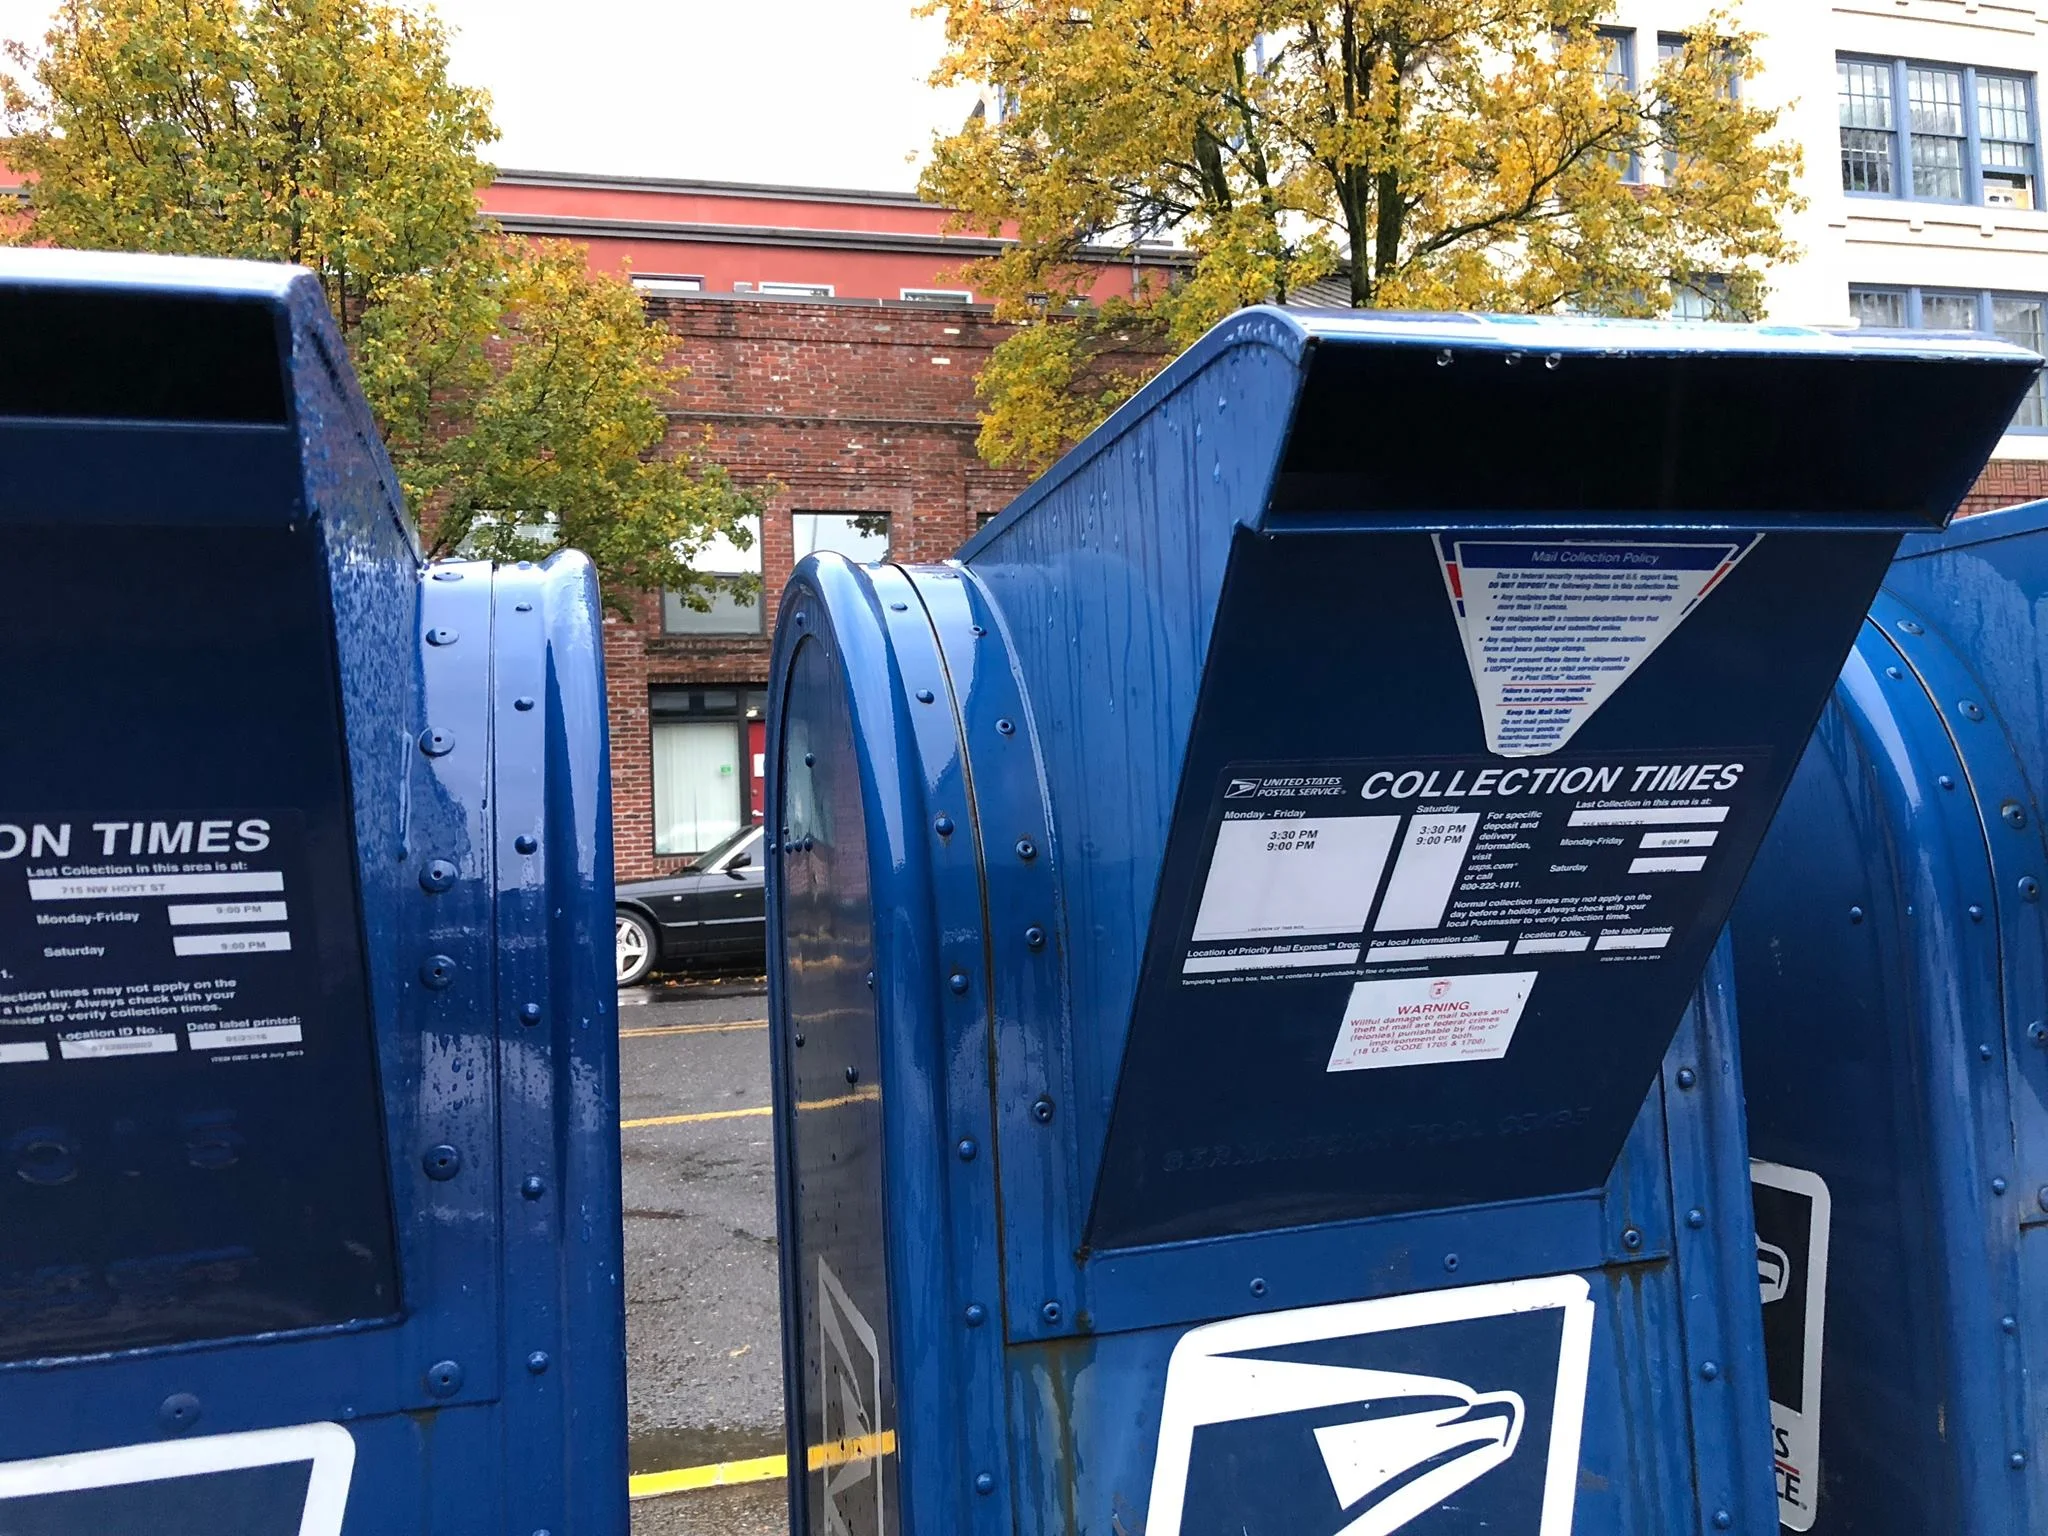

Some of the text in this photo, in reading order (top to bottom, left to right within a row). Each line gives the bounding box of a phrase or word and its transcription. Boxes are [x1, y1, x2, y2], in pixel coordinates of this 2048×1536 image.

[1531, 551, 1659, 565] Mail Collection Policy
[1263, 777, 1342, 787] UNITED STATES
[1360, 763, 1744, 800] COLLECTION TIMES
[1257, 788, 1297, 797] POSTAL
[1576, 801, 1596, 809] Last
[1597, 799, 1641, 808] Collection
[1643, 799, 1651, 807] in
[1691, 798, 1699, 806] is
[1224, 811, 1265, 820] Monday
[1273, 809, 1306, 819] Friday
[1416, 805, 1460, 814] Saturday
[1487, 811, 1543, 820] For specific
[1419, 824, 1467, 835] 3:30 PM
[1483, 821, 1539, 831] deposit and
[92, 819, 271, 855] TIMES
[1270, 830, 1319, 840] 3:30 PM
[1415, 835, 1463, 846] 9:00 PM
[1479, 832, 1517, 841] delivery
[1267, 840, 1316, 851] 9:00 PM
[1475, 842, 1531, 850] information,
[1560, 837, 1624, 847] Monday-Friday
[26, 861, 248, 877] Last Collection in this area is at:
[1549, 863, 1588, 873] Saturday
[1476, 872, 1493, 880] call
[87, 885, 108, 894] NW
[112, 884, 146, 892] HOYT
[150, 883, 166, 892] ST
[1460, 881, 1521, 890] 800-222-1811.
[1453, 900, 1487, 909] Normal
[1488, 898, 1533, 907] collection
[1561, 896, 1580, 904] may
[1598, 894, 1623, 903] apply
[1637, 893, 1652, 901] the
[244, 905, 262, 914] PM
[1450, 911, 1467, 919] day
[1468, 909, 1498, 917] before
[1507, 907, 1542, 916] holiday.
[1544, 905, 1576, 914] Always
[1577, 904, 1604, 912] check
[1605, 903, 1624, 911] with
[1625, 903, 1647, 912] your
[36, 911, 140, 926] Monday-Friday
[1446, 920, 1469, 928] local
[1470, 918, 1522, 927] Postmaster
[1534, 915, 1560, 924] verify
[1561, 914, 1604, 923] collection
[1605, 913, 1631, 921] times.
[1519, 931, 1556, 939] Location
[1557, 930, 1567, 938] ID
[1600, 926, 1675, 936] Date label printed:
[248, 941, 267, 949] PM
[1370, 934, 1481, 947] For local information call:
[43, 946, 105, 958] Saturday
[1187, 948, 1225, 958] Location
[1227, 947, 1237, 955] of
[1238, 946, 1272, 955] Priority
[1272, 944, 1291, 953] Mail
[1337, 941, 1361, 950] Drop:
[49, 989, 89, 999] times
[93, 987, 122, 996] may
[126, 984, 149, 994] not
[153, 981, 190, 993] apply
[194, 981, 211, 989] on
[214, 979, 236, 989] the
[3, 991, 236, 1015] a holiday. Always check with your
[1398, 1001, 1470, 1015] WARNING
[49, 1014, 64, 1022] to
[67, 1010, 106, 1021] verify
[110, 1006, 178, 1018] collection
[180, 1004, 222, 1014] times.
[1350, 1017, 1381, 1027] Willful
[1383, 1016, 1422, 1026] damage
[1437, 1011, 1457, 1019] mail
[1460, 1009, 1489, 1018] boxes
[1491, 1007, 1509, 1015] and
[187, 1016, 301, 1032] Date label printed:
[1353, 1016, 1500, 1034] theft of mail are federal crimes
[57, 1029, 115, 1041] Location
[119, 1027, 133, 1036] ID
[1350, 1031, 1395, 1042] (felonies)
[1397, 1028, 1451, 1039] punishable
[1453, 1025, 1465, 1034] by
[1468, 1022, 1486, 1031] fine
[1369, 1036, 1432, 1048] imprisonment
[1352, 1047, 1368, 1056] (18
[1394, 1043, 1423, 1052] CODE
